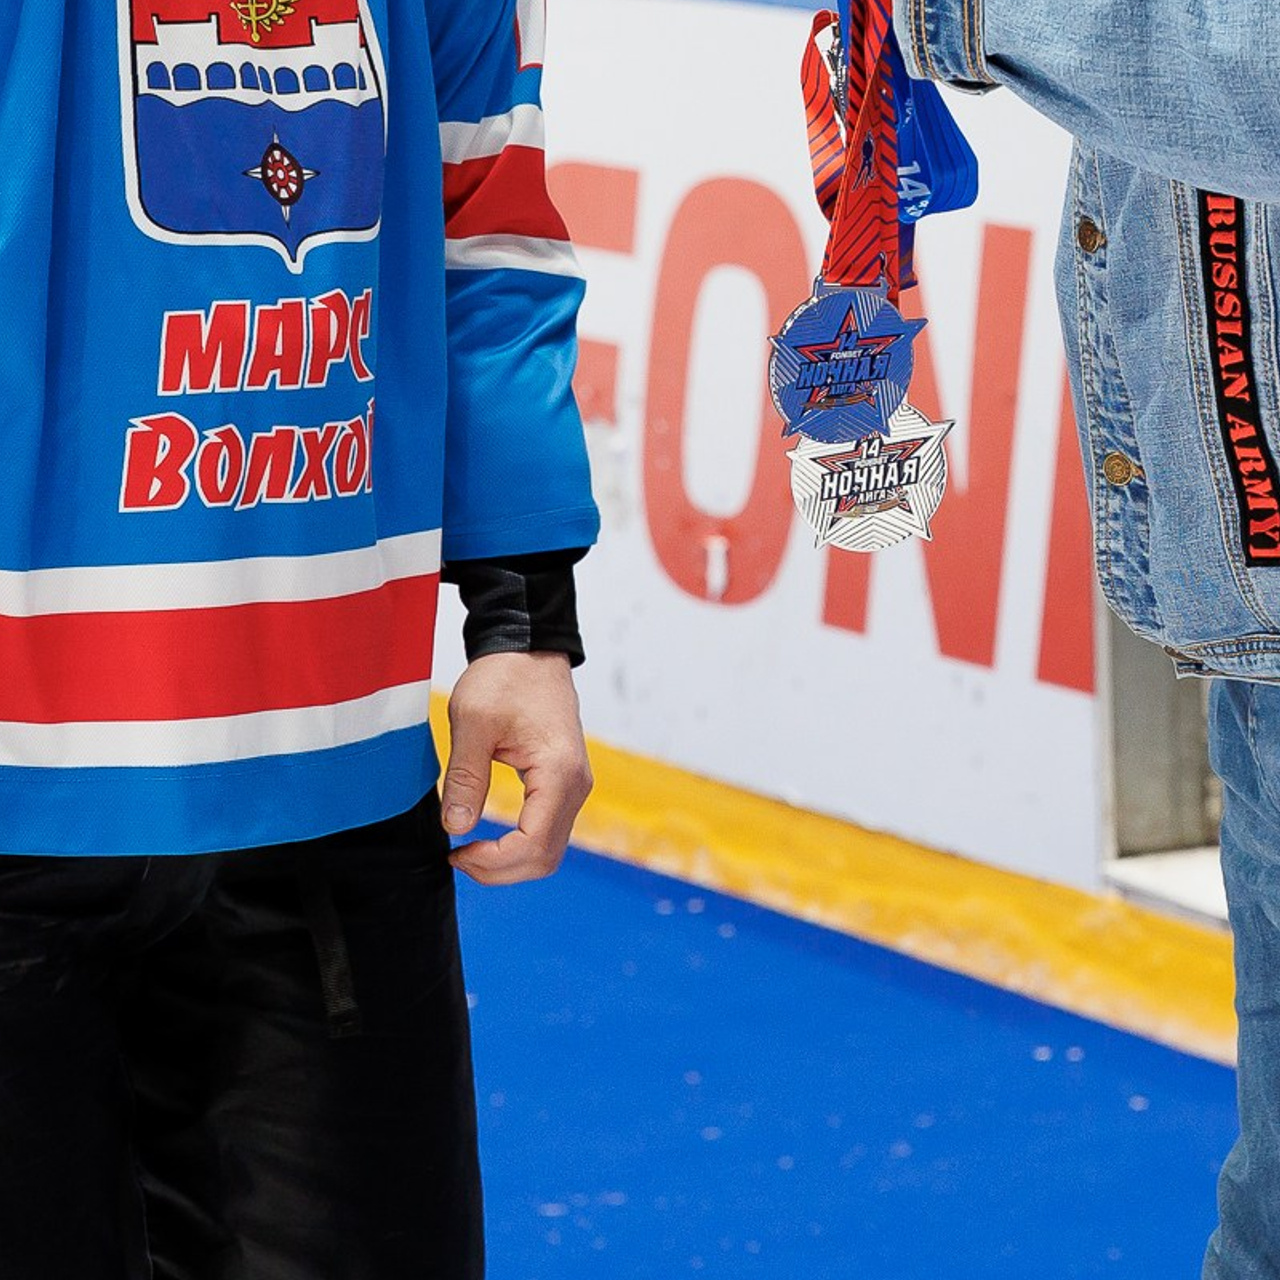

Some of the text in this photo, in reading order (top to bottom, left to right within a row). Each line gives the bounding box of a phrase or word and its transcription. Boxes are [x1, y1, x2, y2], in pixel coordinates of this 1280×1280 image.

[1206, 194, 1251, 402] RUSSIAN
[156, 287, 375, 397] МАРС
[798, 354, 890, 389] НОЧНАЯ
[860, 438, 881, 459] 14
[823, 458, 918, 500] НОЧНАЯ
[858, 489, 886, 504] ЛИГА
